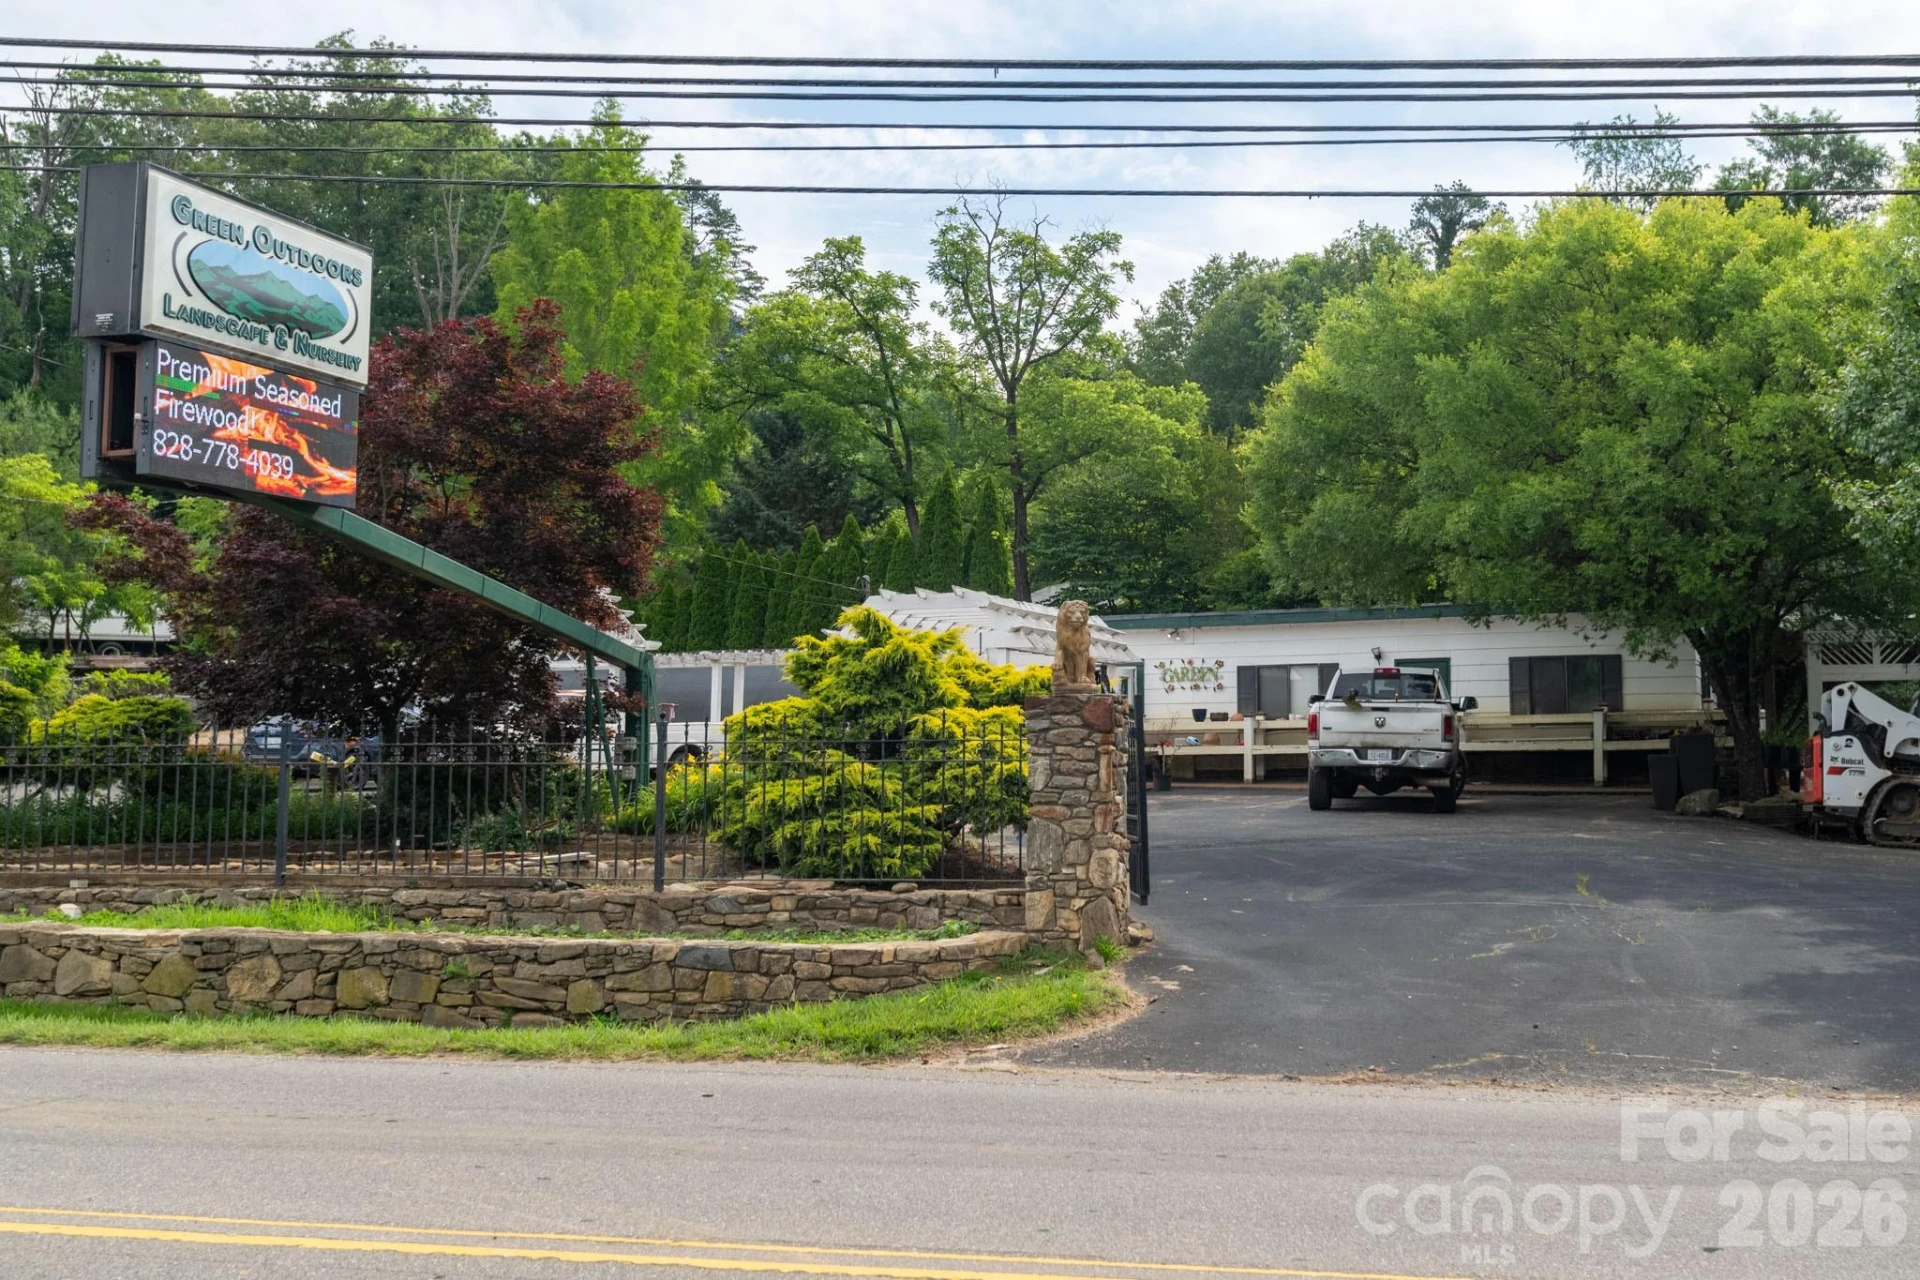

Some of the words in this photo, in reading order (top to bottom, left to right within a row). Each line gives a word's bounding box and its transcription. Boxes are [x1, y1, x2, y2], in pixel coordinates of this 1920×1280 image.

[274, 323, 289, 351] &
[157, 348, 247, 396] Premium
[254, 375, 342, 419] Seasoned
[153, 428, 294, 480] 828-778-4039
[1841, 757, 1864, 766] Bobcat
